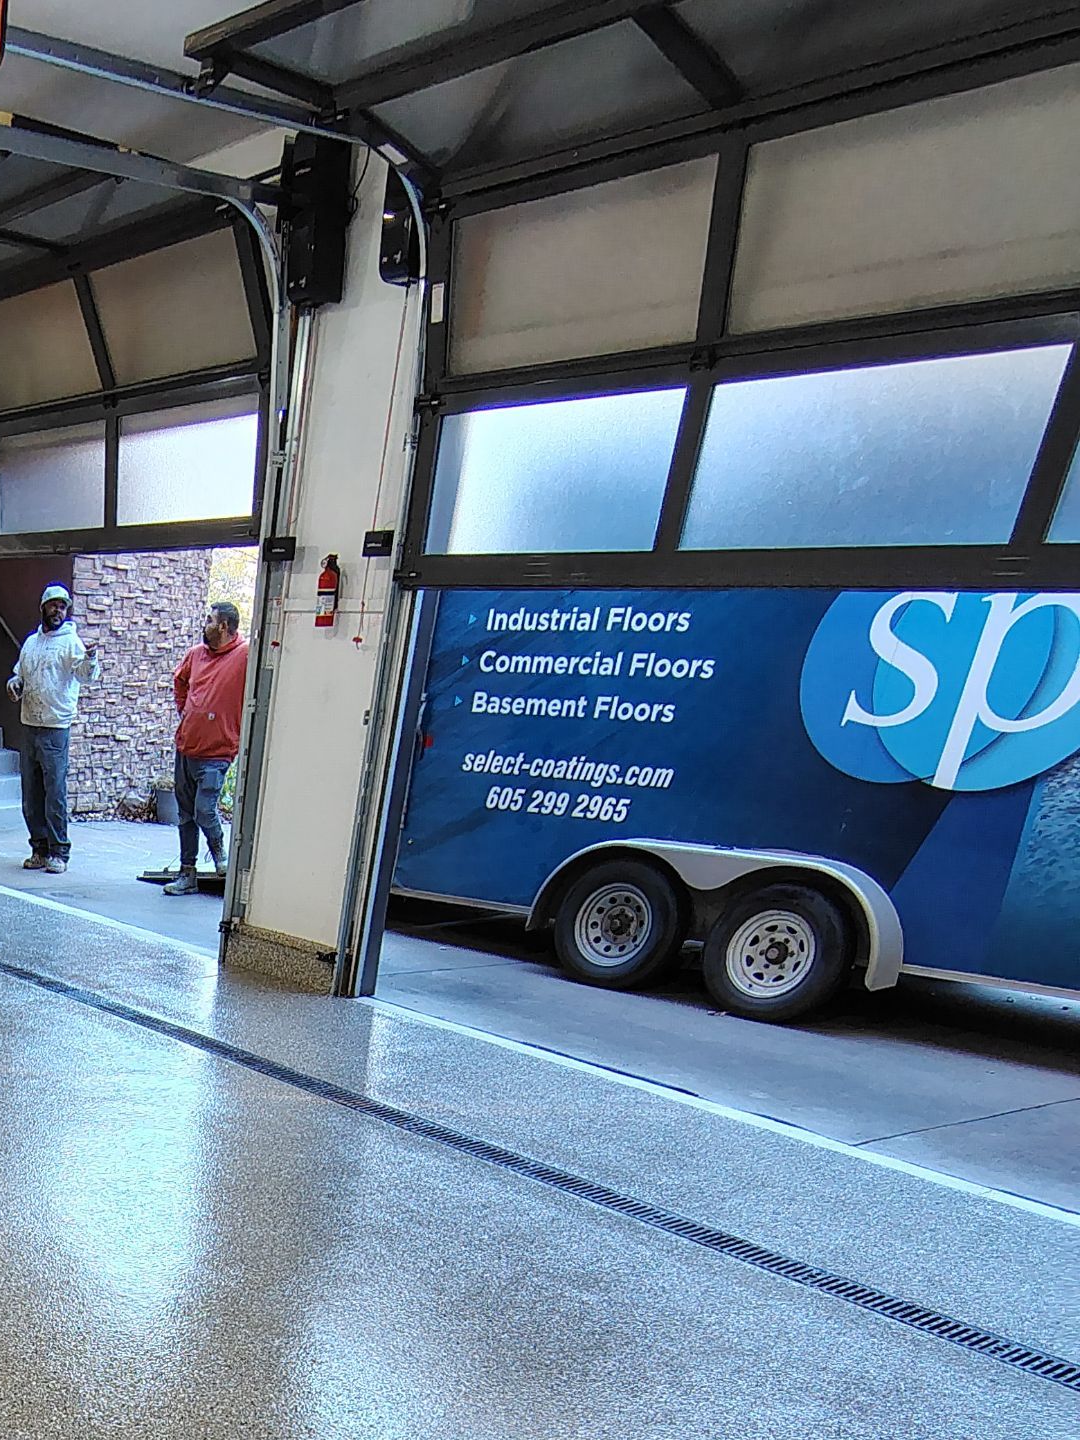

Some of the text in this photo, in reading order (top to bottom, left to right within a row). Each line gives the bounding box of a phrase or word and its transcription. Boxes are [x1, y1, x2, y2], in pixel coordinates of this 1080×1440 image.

[486, 606, 692, 633] Industrial Floors
[479, 650, 716, 679] Commercial Floors
[471, 691, 676, 723] Basement Floors
[461, 749, 675, 788] select-coatings.com
[485, 785, 631, 823] 605 299 2965
